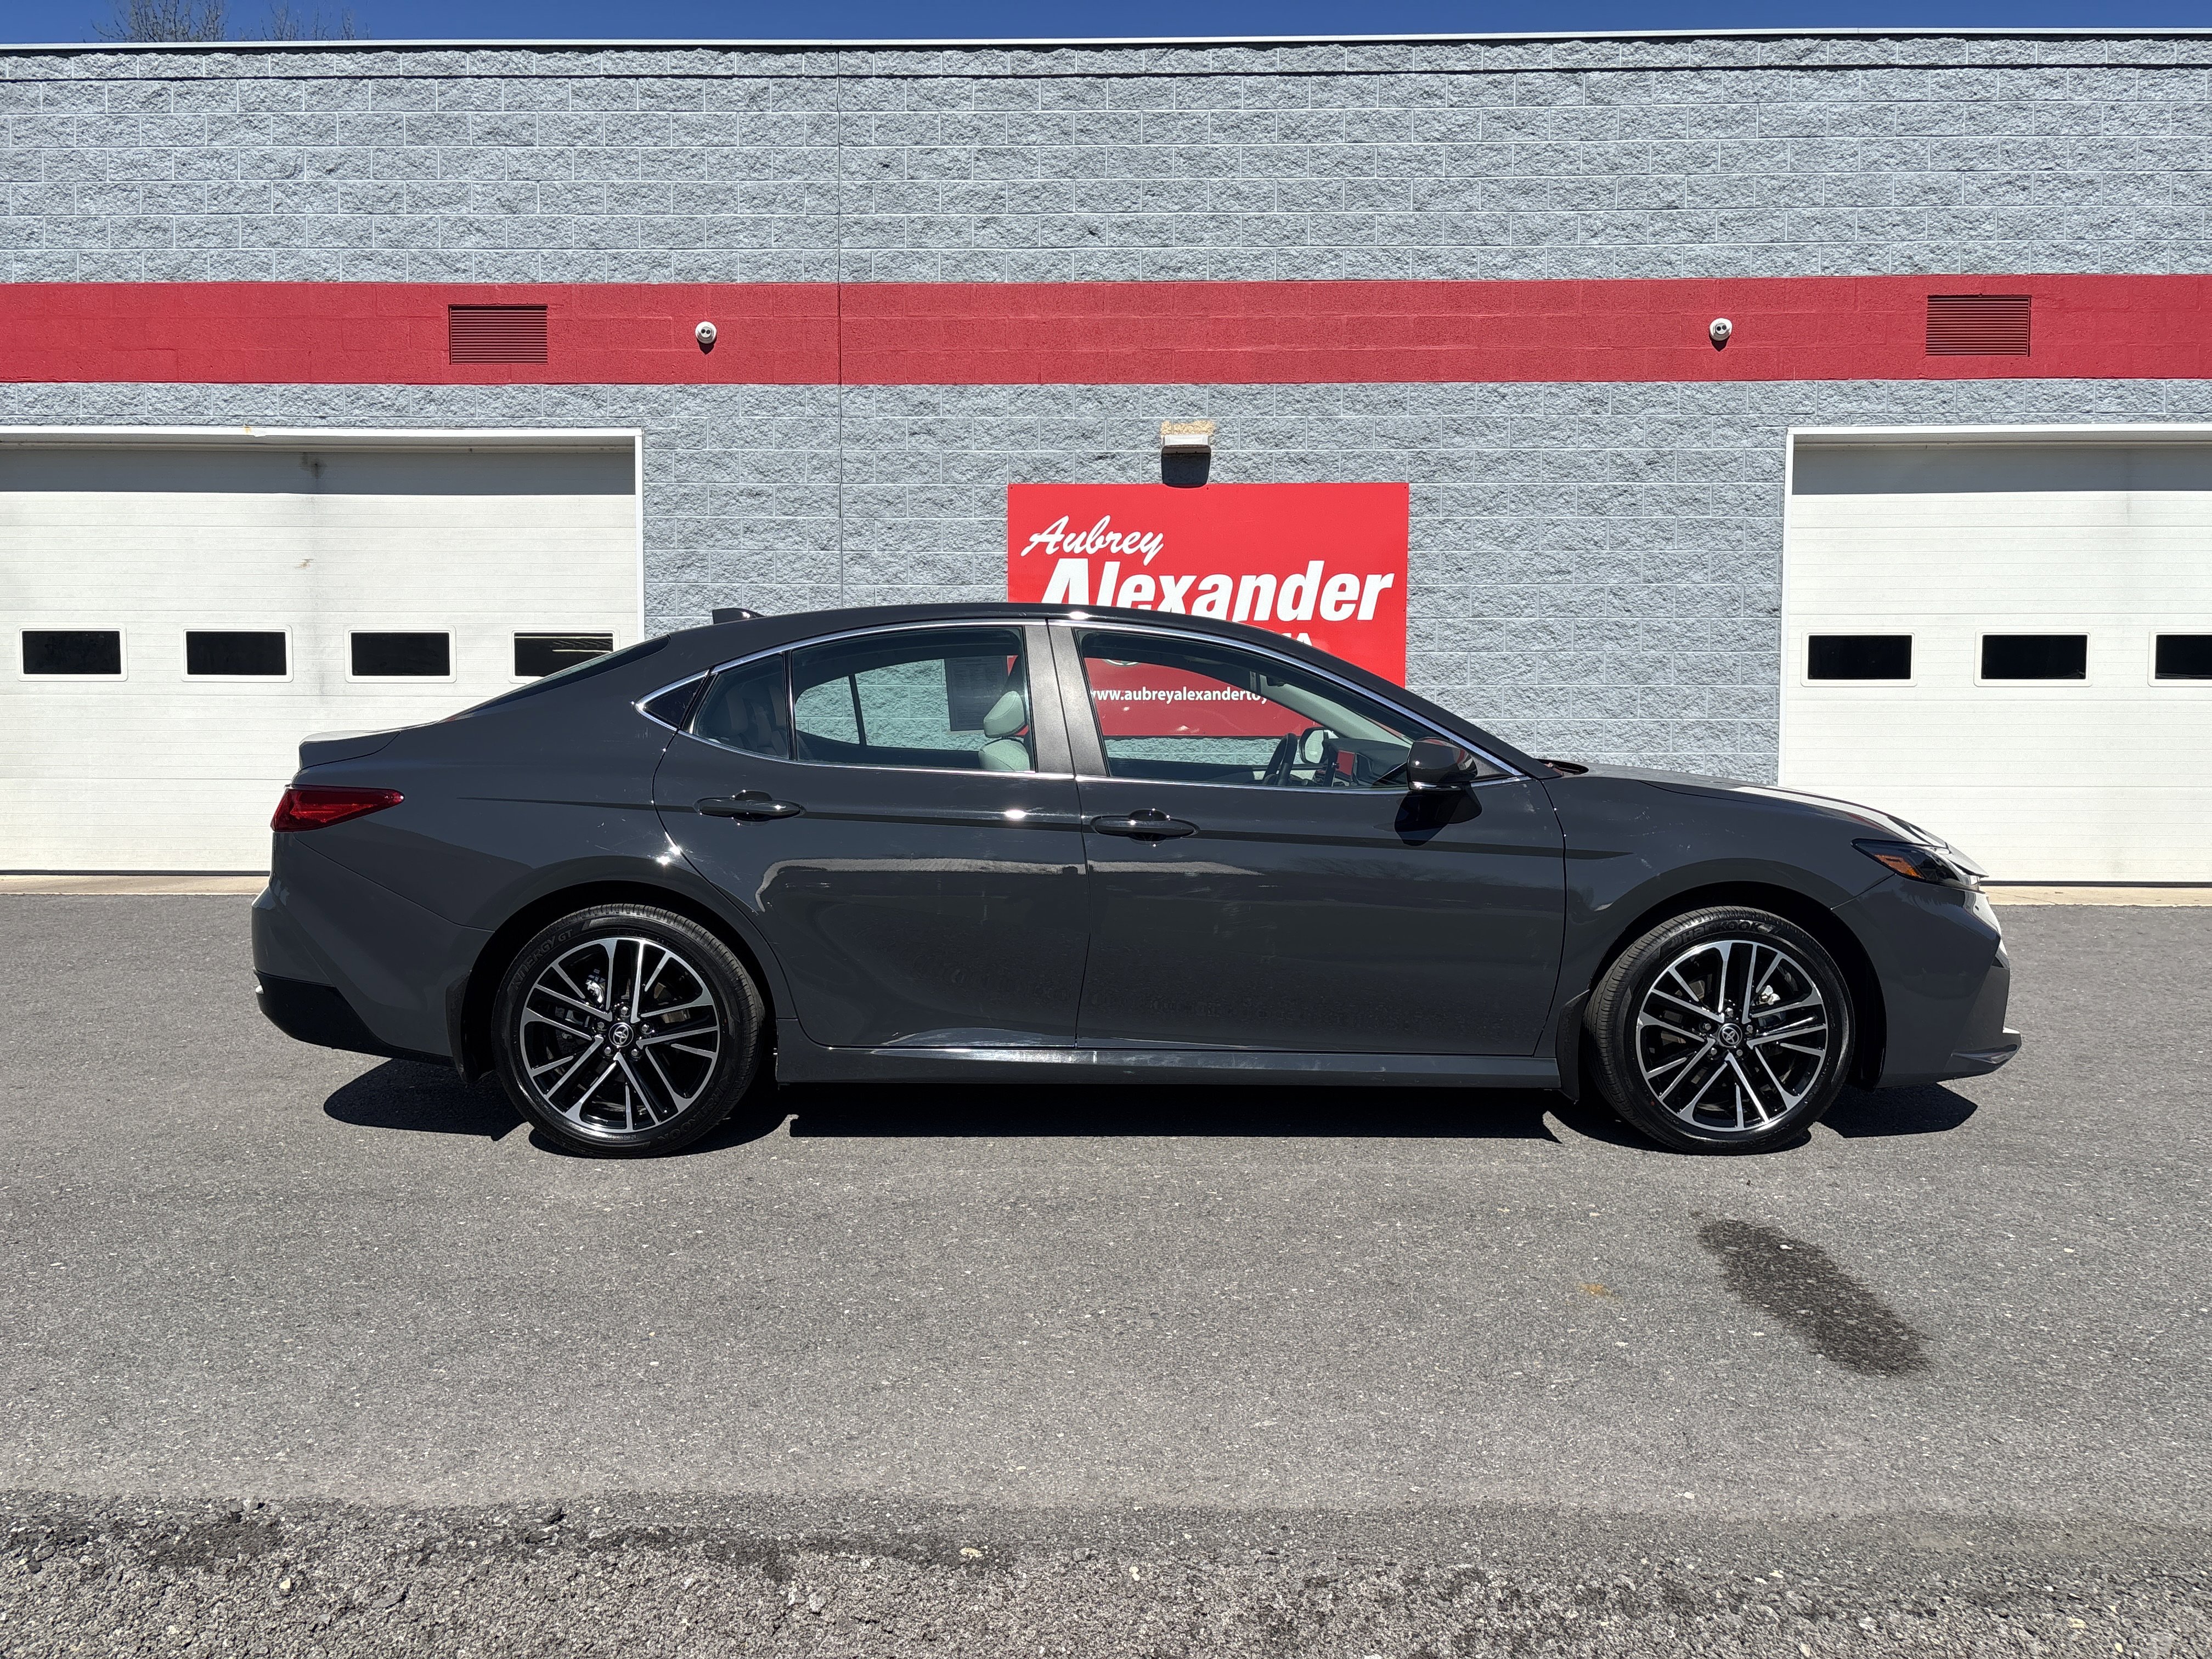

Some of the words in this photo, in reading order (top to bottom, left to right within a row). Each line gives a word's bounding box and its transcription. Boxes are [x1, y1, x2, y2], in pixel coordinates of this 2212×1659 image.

[1021, 515, 1164, 565] Aubrey
[1041, 558, 1395, 622] Alexander
[557, 928, 574, 943] GT
